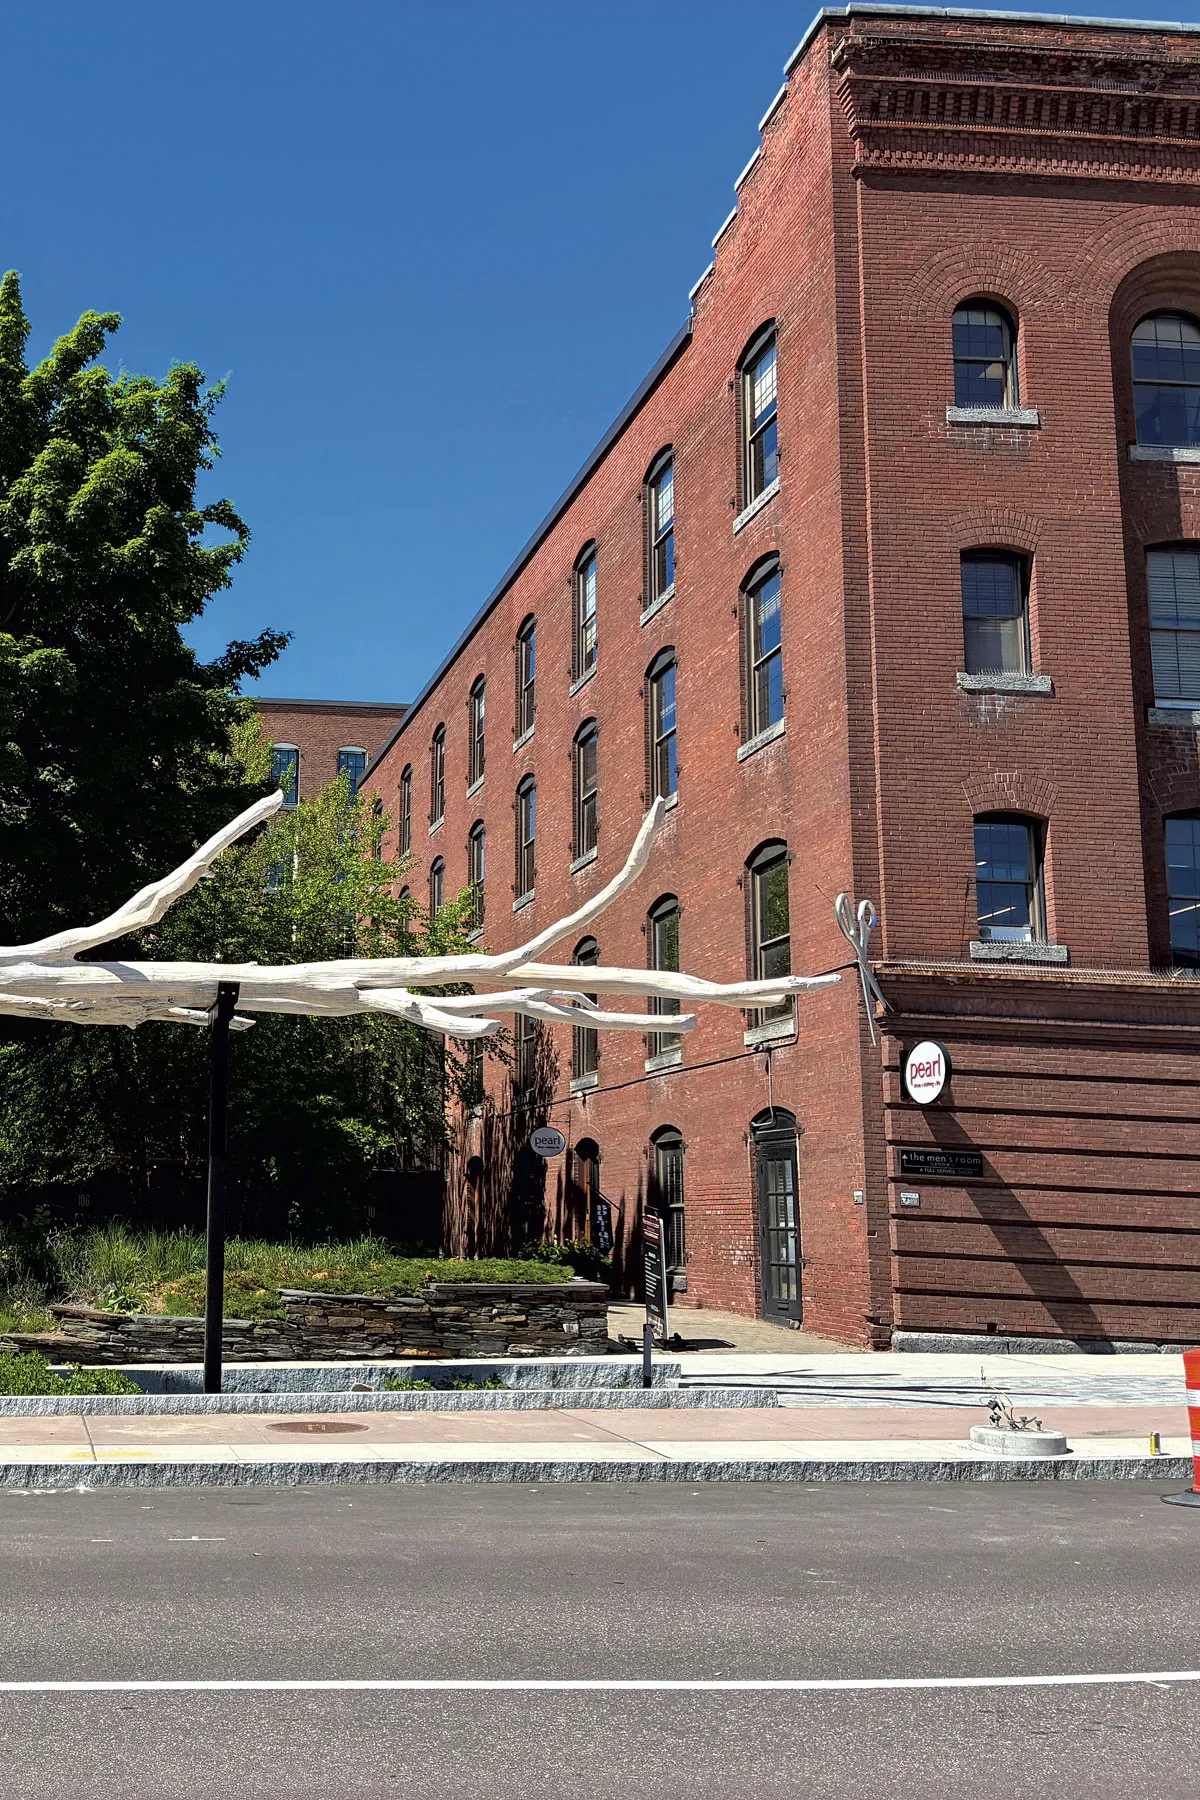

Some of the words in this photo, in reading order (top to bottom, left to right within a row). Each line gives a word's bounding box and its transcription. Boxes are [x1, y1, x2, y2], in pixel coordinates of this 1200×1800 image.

[910, 1053, 941, 1087] pearl
[535, 1135, 560, 1147] pearl
[909, 1152, 925, 1162] the
[927, 1154, 953, 1163] men's
[955, 1157, 981, 1165] room
